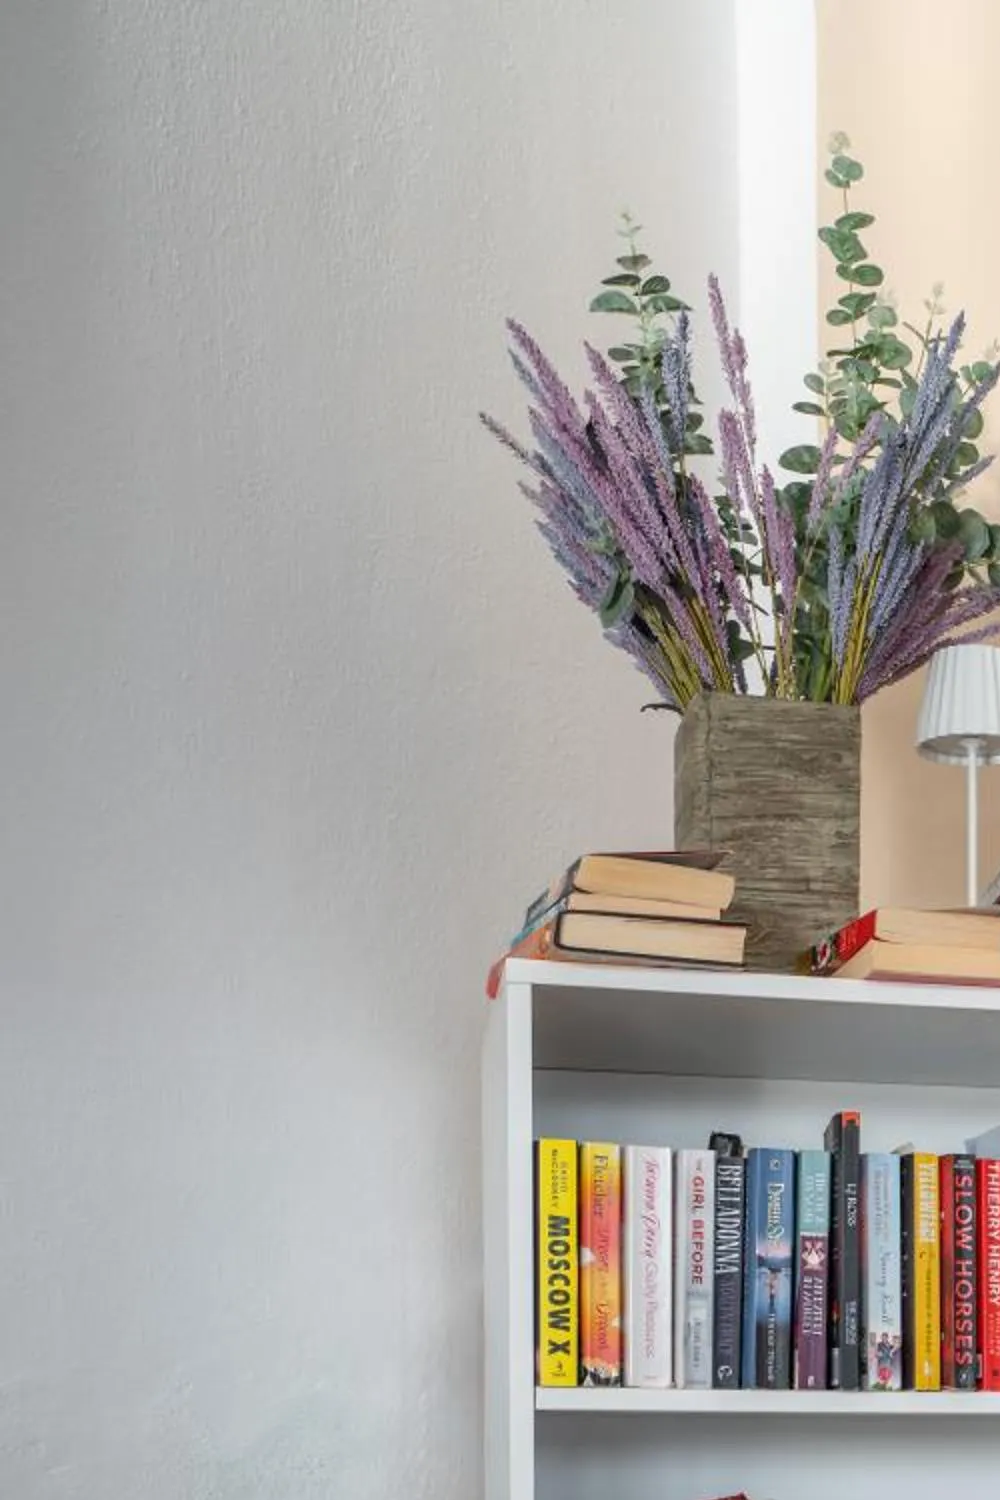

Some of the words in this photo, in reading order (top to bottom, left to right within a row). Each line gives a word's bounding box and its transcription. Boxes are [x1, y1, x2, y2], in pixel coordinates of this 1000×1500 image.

[593, 1154, 609, 1218] Fletcher
[691, 1175, 704, 1214] GIRL
[715, 1164, 741, 1275] BELLADONNA
[846, 1197, 856, 1231] ROSS
[954, 1174, 973, 1251] SLOW
[987, 1161, 1000, 1241] THIERRY
[547, 1214, 571, 1332] MOSCOW
[691, 1219, 704, 1286] BEFORE
[987, 1244, 1000, 1307] HENRY
[954, 1258, 974, 1367] HORSES
[547, 1339, 571, 1357] X
